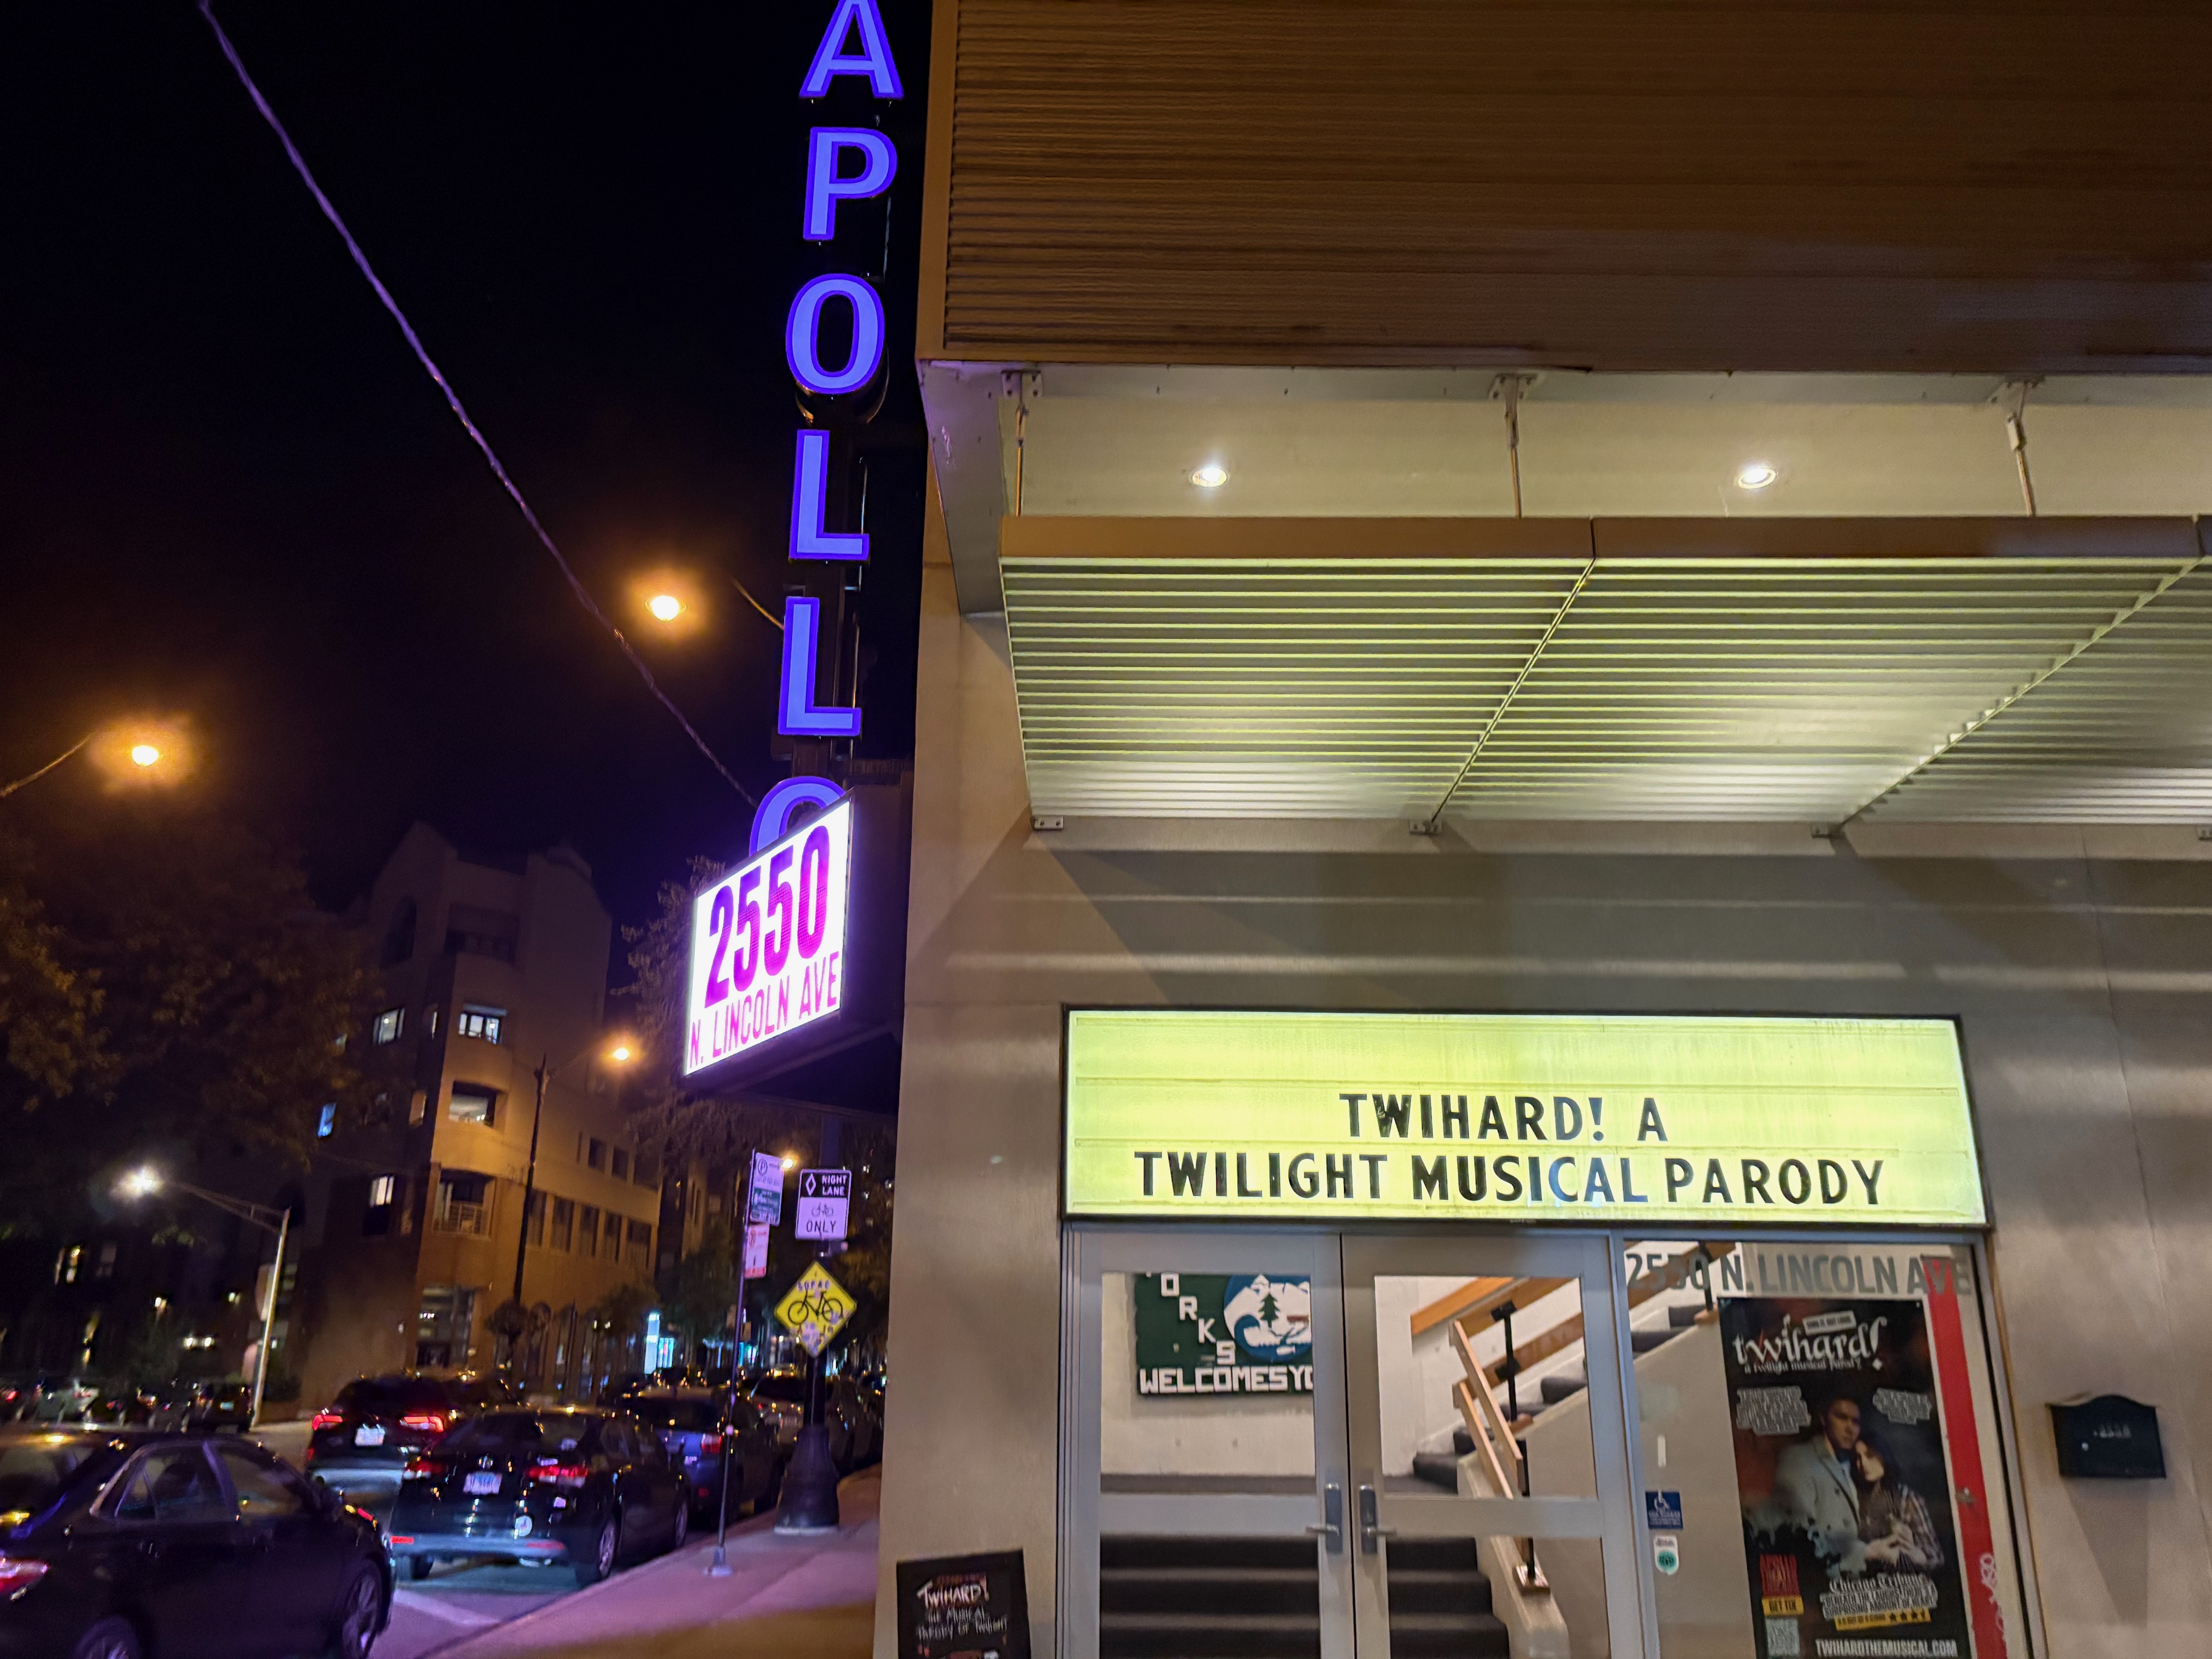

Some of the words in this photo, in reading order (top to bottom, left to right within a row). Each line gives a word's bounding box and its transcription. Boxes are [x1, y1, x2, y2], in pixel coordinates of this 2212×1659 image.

[705, 825, 830, 1008] 2550
[713, 975, 790, 1058] LINCOLN
[799, 951, 839, 1020] AVE
[1339, 1093, 1603, 1141] TWIHARD!
[1637, 1097, 1668, 1142] A
[822, 1186, 845, 1196] LANE
[1134, 1151, 1388, 1199] TWILIGHT
[1411, 1154, 1648, 1202] MUSICAL
[1664, 1158, 1884, 1205] PARODY
[806, 1219, 836, 1233] ONLY
[1626, 1253, 1707, 1291] 2550
[1758, 1254, 1898, 1295] LINCOLN
[1906, 1256, 1972, 1295] AVE
